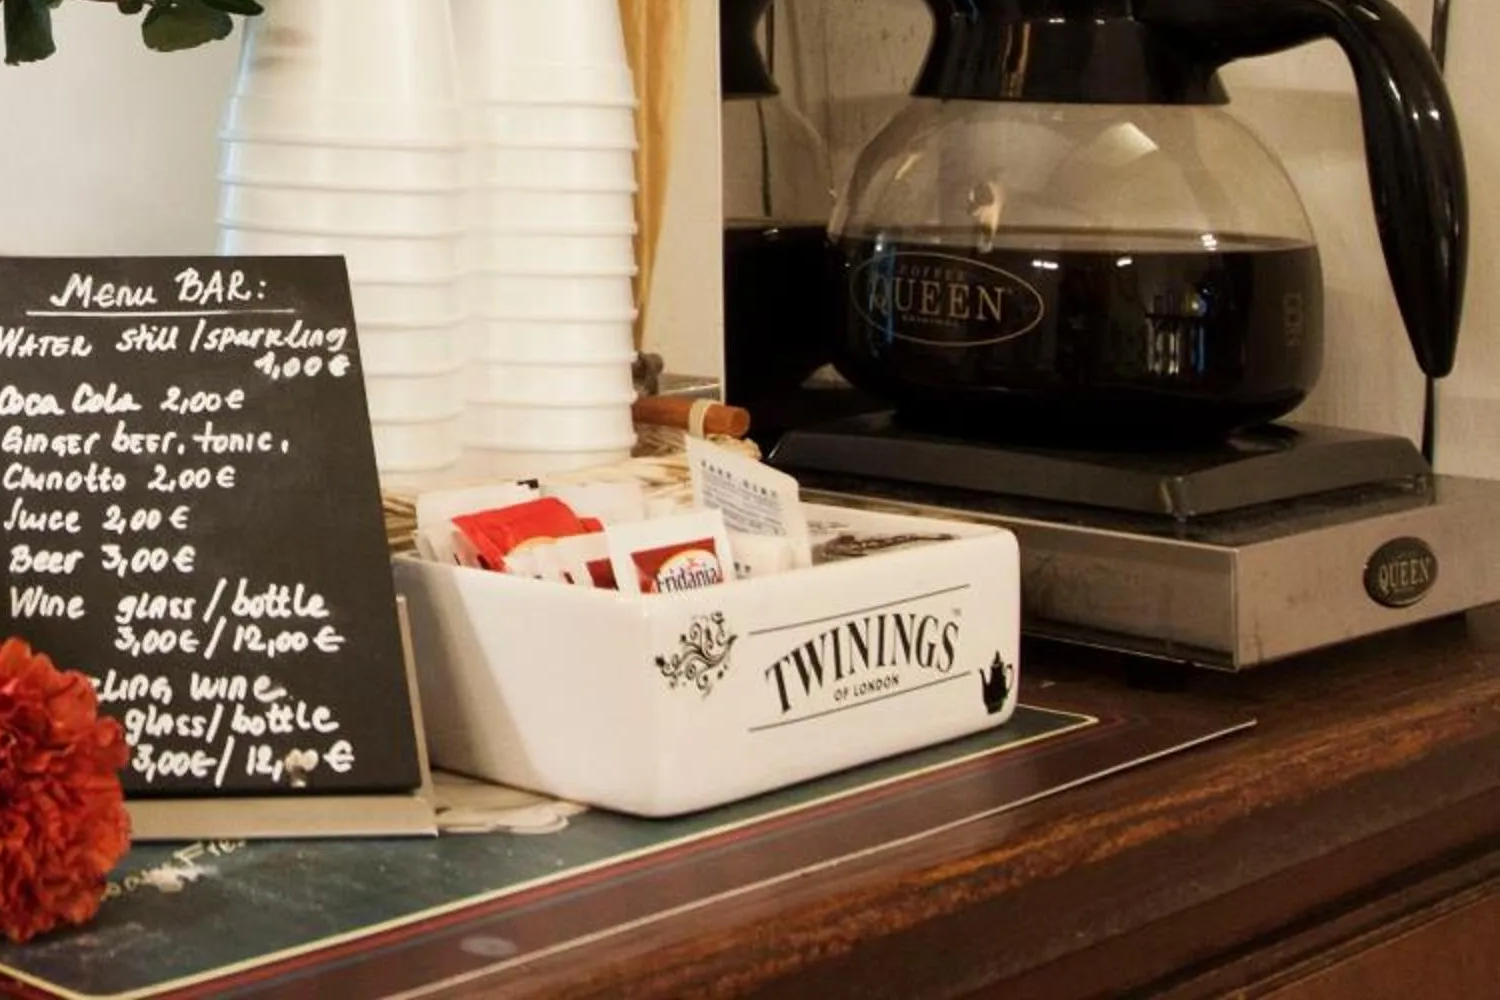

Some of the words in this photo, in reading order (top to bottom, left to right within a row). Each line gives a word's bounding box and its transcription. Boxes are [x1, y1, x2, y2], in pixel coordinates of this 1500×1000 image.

[49, 272, 158, 309] Menu
[174, 266, 268, 305] BAR:
[71, 382, 143, 415] Cola
[3, 497, 83, 533] Juice
[8, 543, 85, 574] Beer
[9, 585, 85, 620] Wine
[764, 611, 961, 715] TWININGS
[833, 687, 850, 703] OF
[853, 674, 900, 698] LONDON
